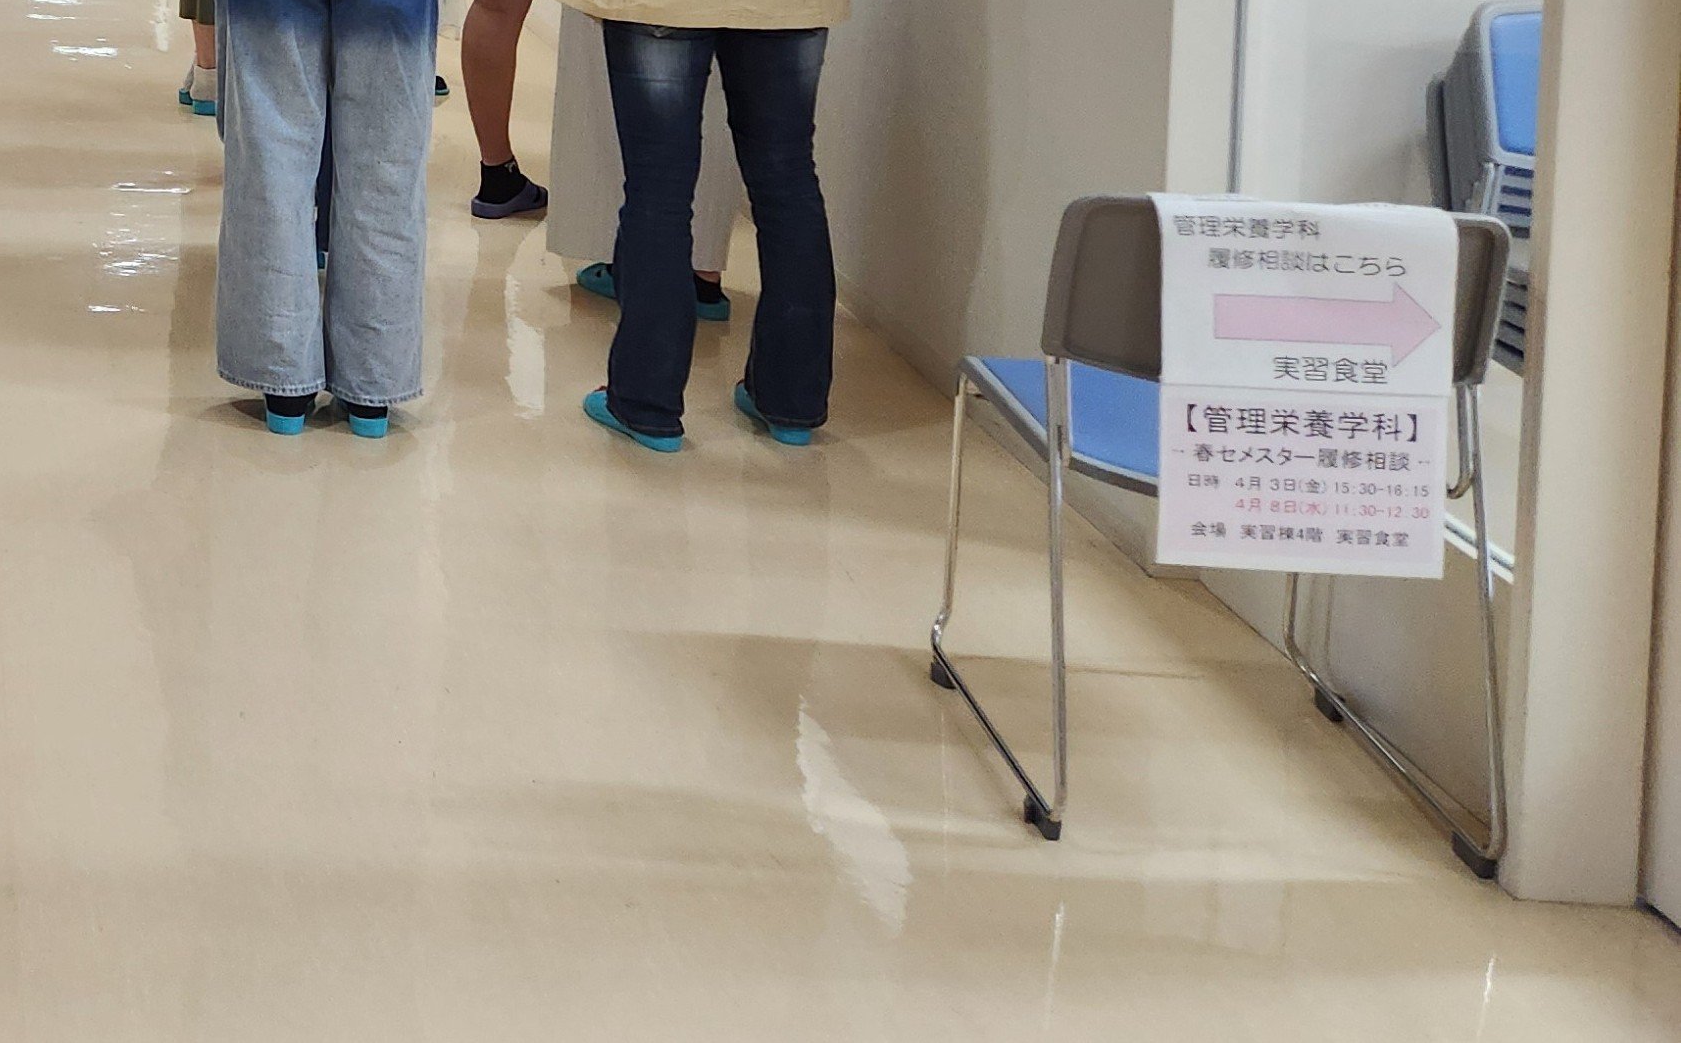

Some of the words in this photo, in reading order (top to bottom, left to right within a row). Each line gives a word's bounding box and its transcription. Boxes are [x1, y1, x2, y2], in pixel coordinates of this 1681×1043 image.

[1172, 215, 1321, 239] 管理栄養学科
[1207, 247, 1408, 277] 履修相談はこちら
[1272, 355, 1389, 385] 実習食堂
[1186, 403, 1419, 443] 【管理栄養学科】
[1188, 474, 1220, 488] 日時
[1191, 521, 1226, 539] 会場
[1336, 528, 1409, 548] 実習食堂
